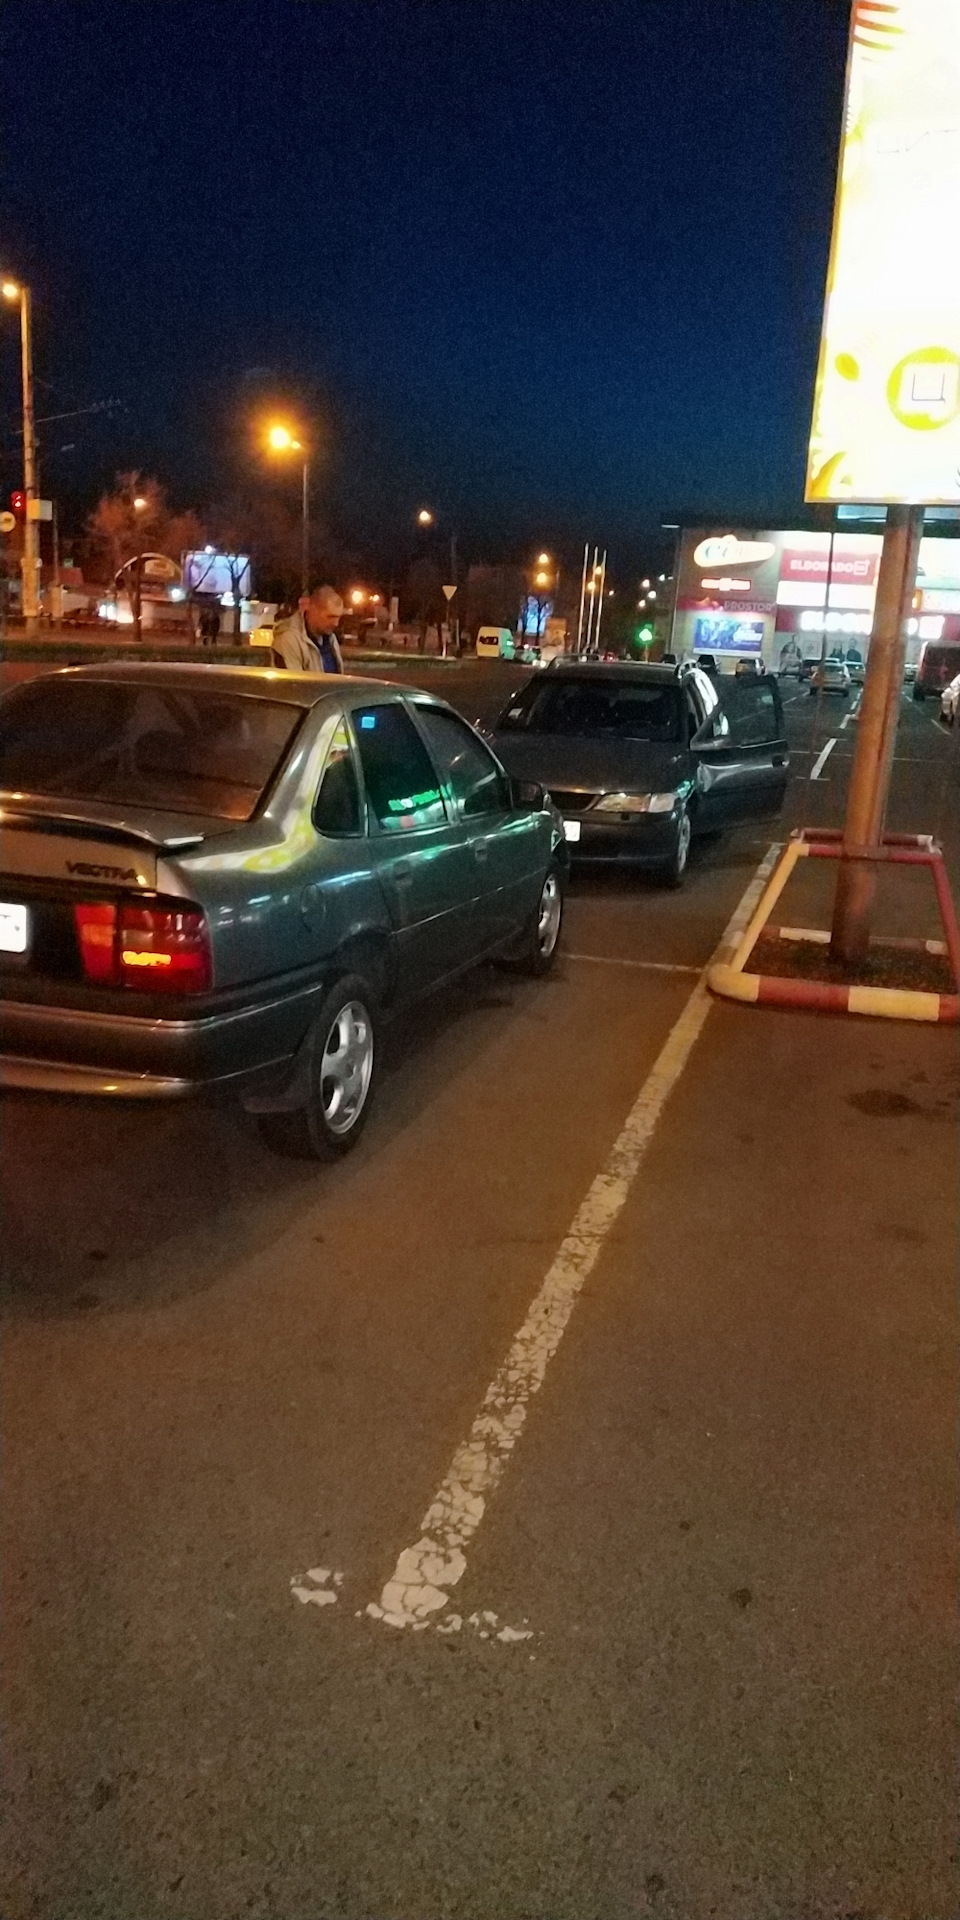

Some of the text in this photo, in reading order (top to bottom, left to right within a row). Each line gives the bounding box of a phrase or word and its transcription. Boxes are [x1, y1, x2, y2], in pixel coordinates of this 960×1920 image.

[790, 559, 853, 573] ELDORADO
[723, 600, 772, 613] PROSTOR
[65, 861, 137, 880] VECTRA
